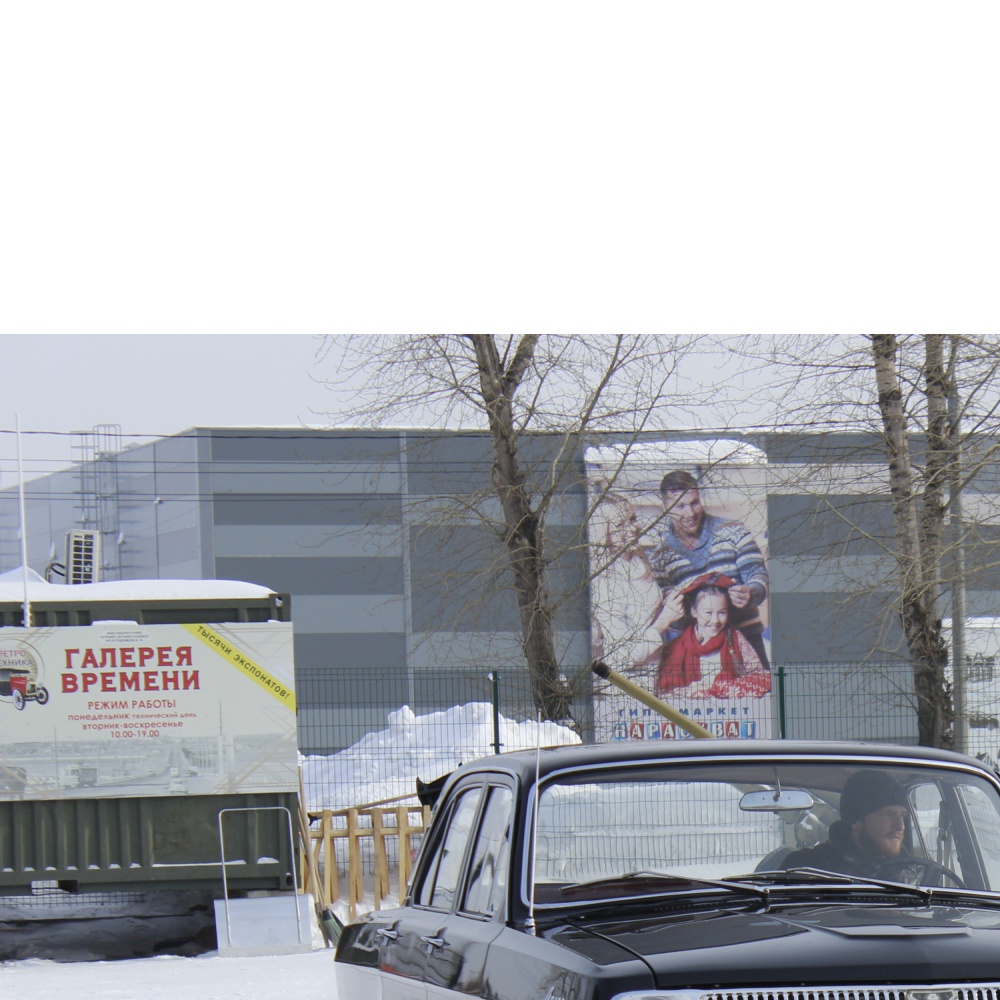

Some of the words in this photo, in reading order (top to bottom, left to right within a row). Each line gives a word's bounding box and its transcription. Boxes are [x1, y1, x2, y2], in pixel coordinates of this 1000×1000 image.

[65, 646, 193, 669] ГАЛЕРЕЯ
[197, 625, 232, 655] ТЫСЯЧИ
[234, 654, 290, 700] ЭКСПОНАТОВ!
[61, 670, 200, 693] ВРЕМЕНИ
[88, 700, 128, 710] РЕЖИМ
[132, 699, 176, 709] РАБОТЫ
[68, 713, 129, 721] понедельник
[132, 711, 178, 719] технический
[179, 711, 197, 719] день
[618, 707, 749, 717] ГИПМАРКЕТ
[82, 721, 183, 731] вторник-воскресенье
[111, 730, 159, 738] 10.00-19.00
